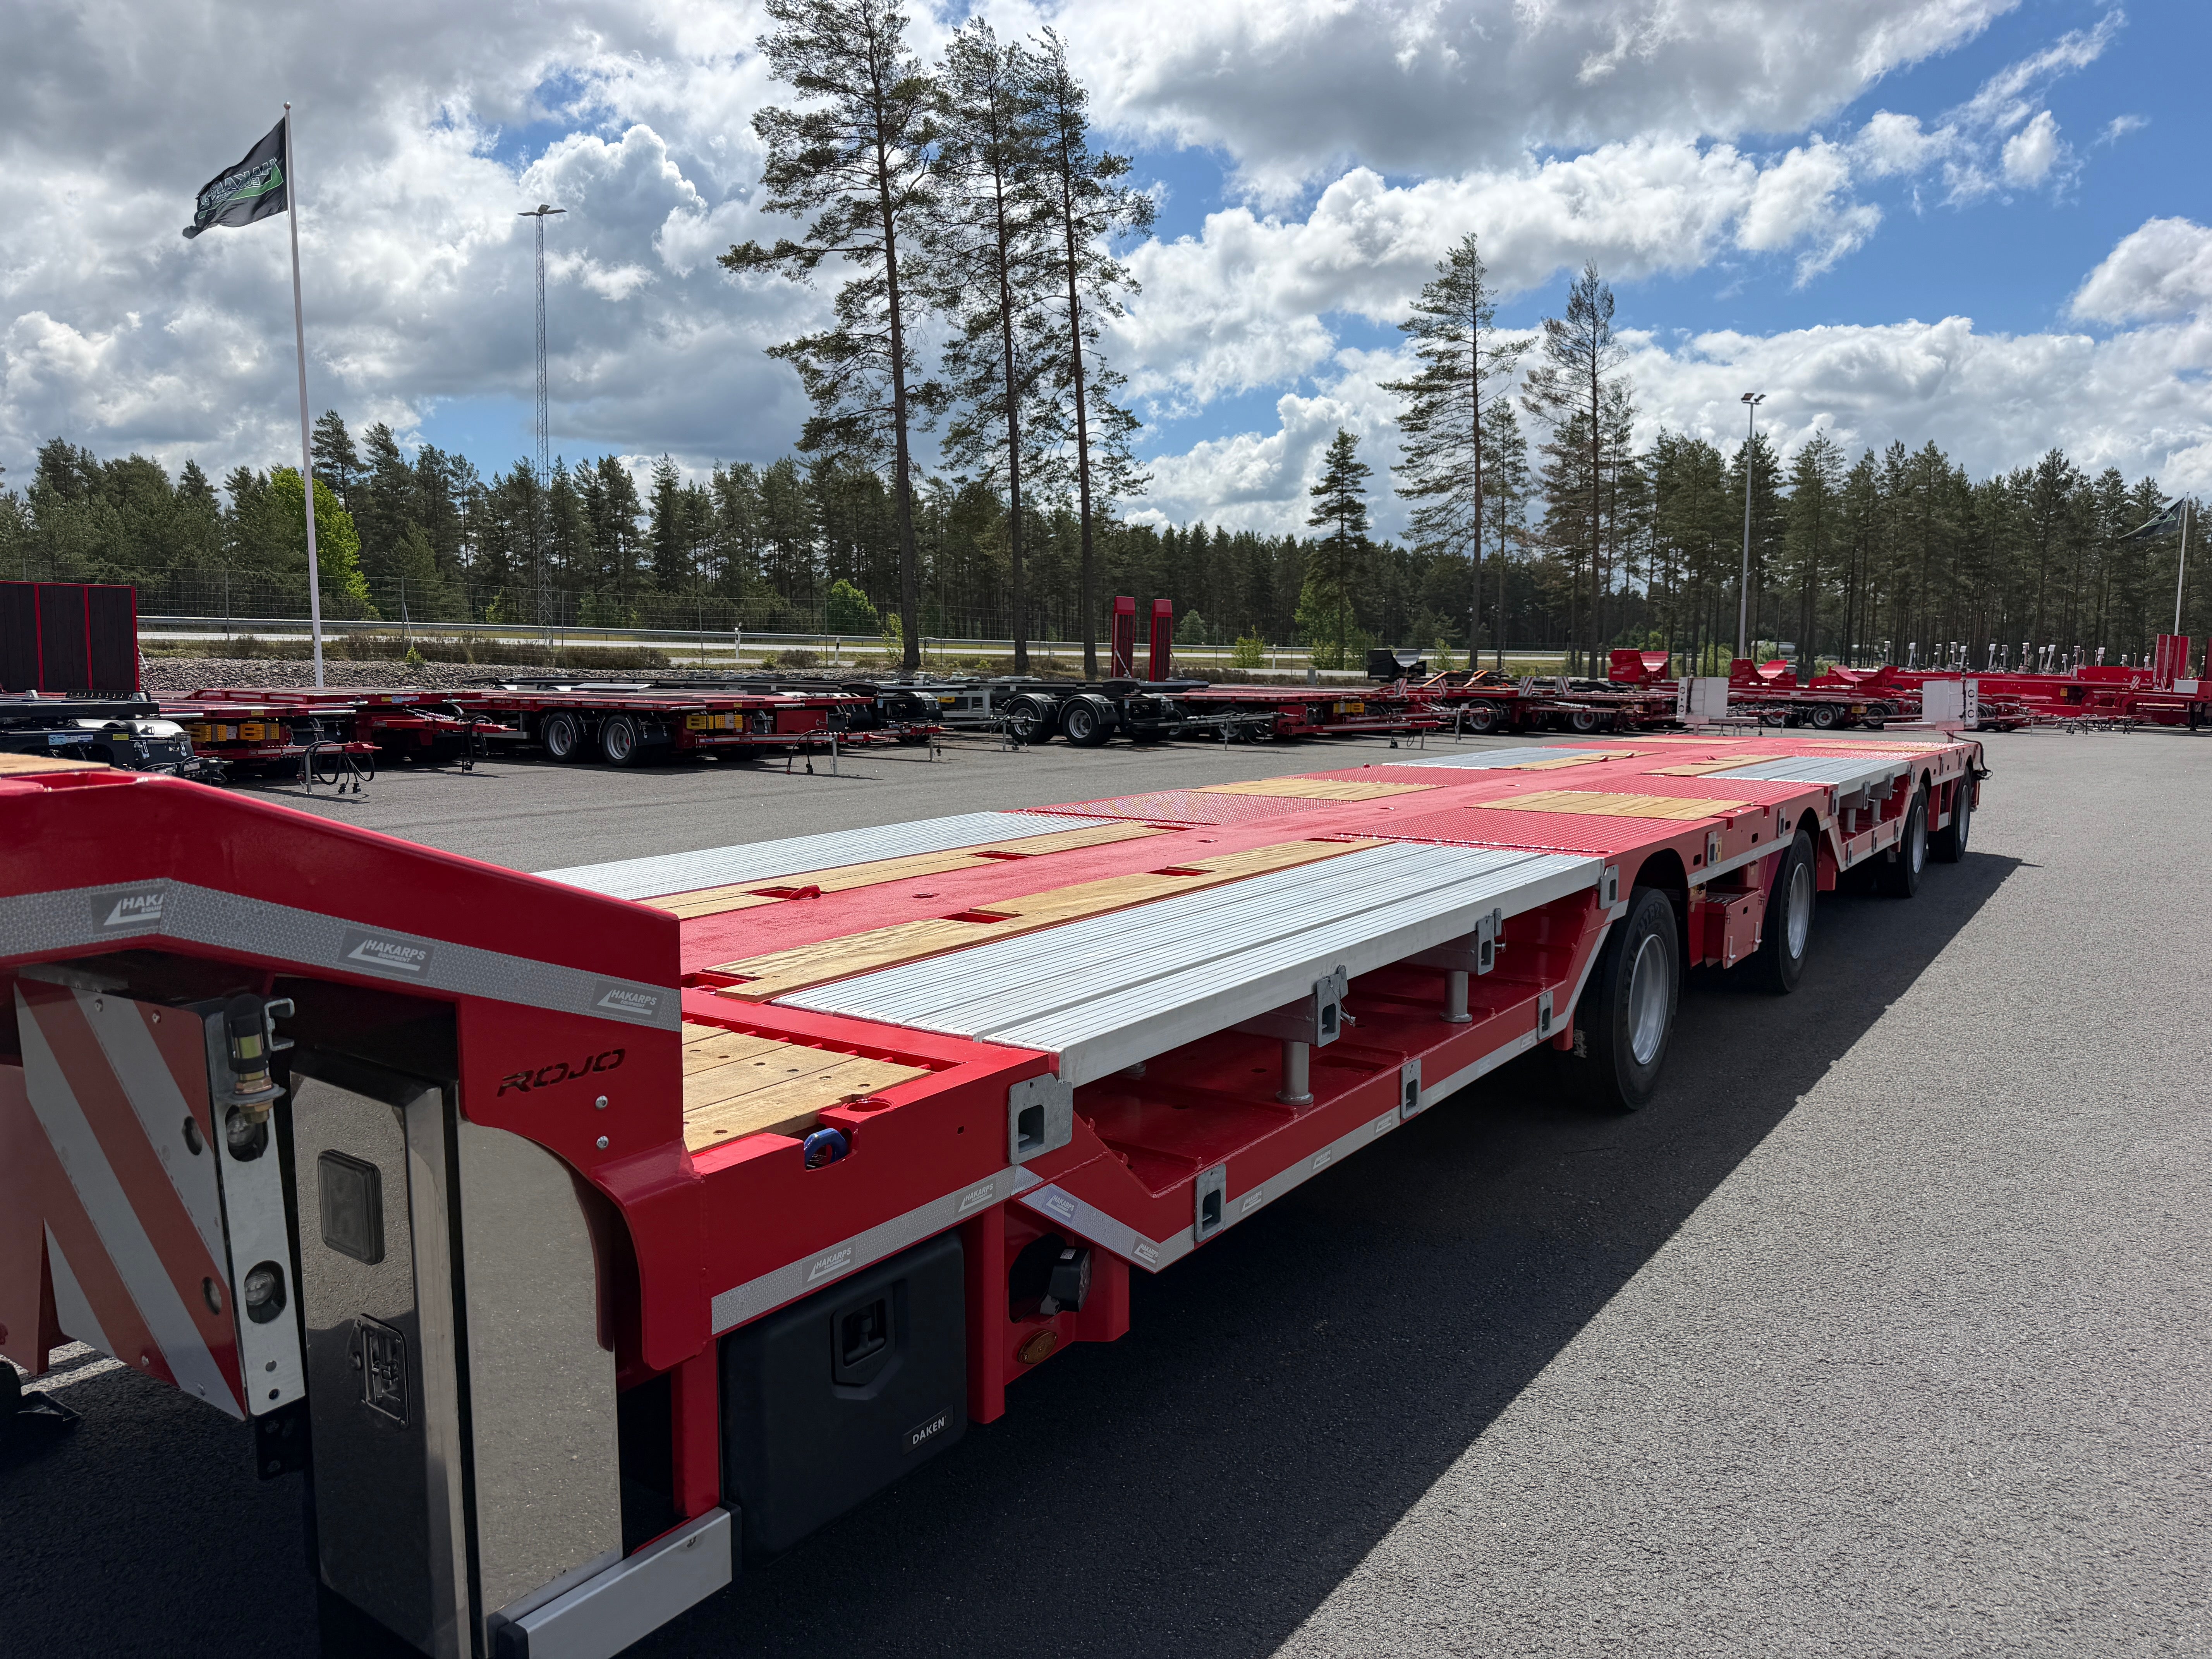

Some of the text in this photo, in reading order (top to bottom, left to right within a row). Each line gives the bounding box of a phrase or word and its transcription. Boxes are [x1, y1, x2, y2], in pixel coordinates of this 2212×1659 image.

[366, 940, 426, 960] HAKARPS
[378, 952, 411, 962] EQUIPMENT
[611, 989, 657, 1005] HAKARPS
[497, 1048, 626, 1097] ROJO
[965, 1183, 993, 1202] HAKARPS
[1053, 1195, 1075, 1211] HAKARPS
[816, 1247, 851, 1269] HAKARPS
[913, 1417, 945, 1445] DAKEN
